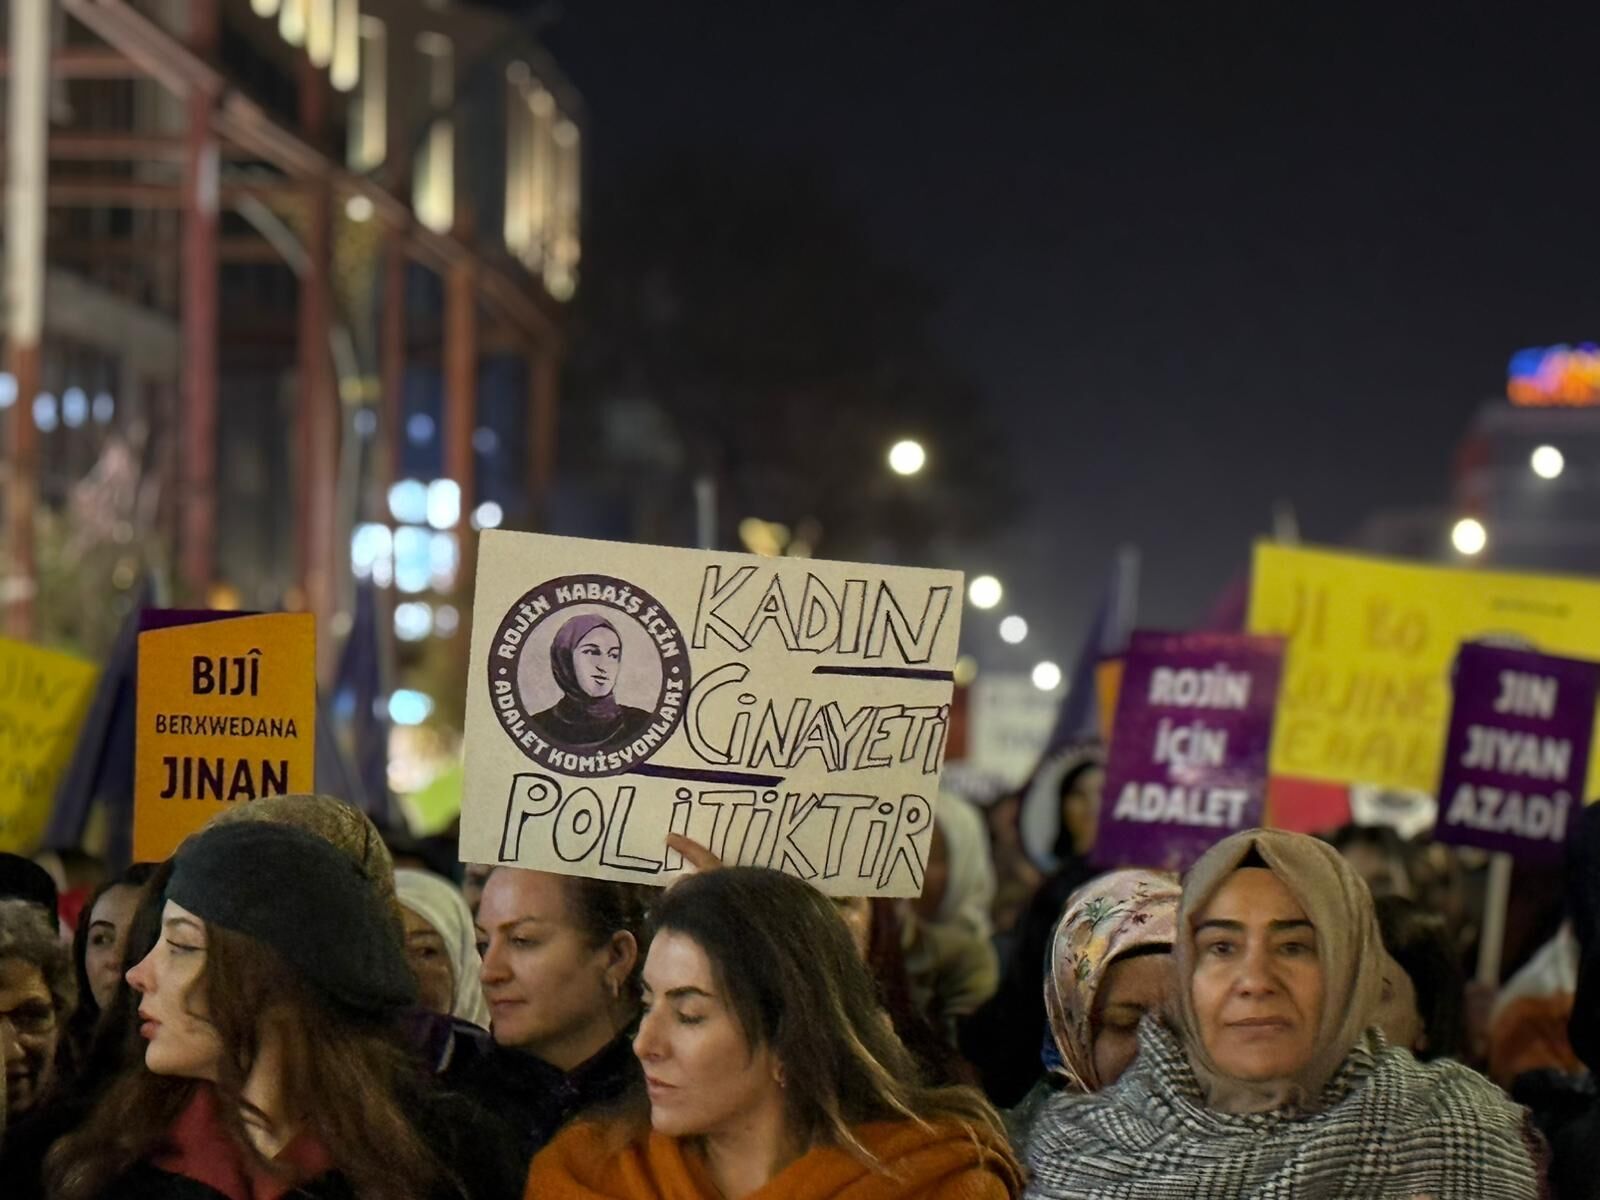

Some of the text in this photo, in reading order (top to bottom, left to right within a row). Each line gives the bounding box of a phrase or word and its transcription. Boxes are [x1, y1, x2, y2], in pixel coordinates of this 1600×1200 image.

[498, 594, 551, 660] ROJİN
[639, 604, 680, 659] İÇİN
[691, 565, 953, 664] KADIN
[192, 648, 263, 696] BIJÎ
[1149, 662, 1252, 709] ROJİN
[1493, 668, 1558, 720] JIN
[155, 713, 298, 738] BERXWEDANA
[494, 678, 684, 772] ADALET KOMİSYONLARI
[1460, 723, 1572, 783] JIYAN
[160, 756, 289, 801] JINAN
[1113, 781, 1249, 828] ADALET
